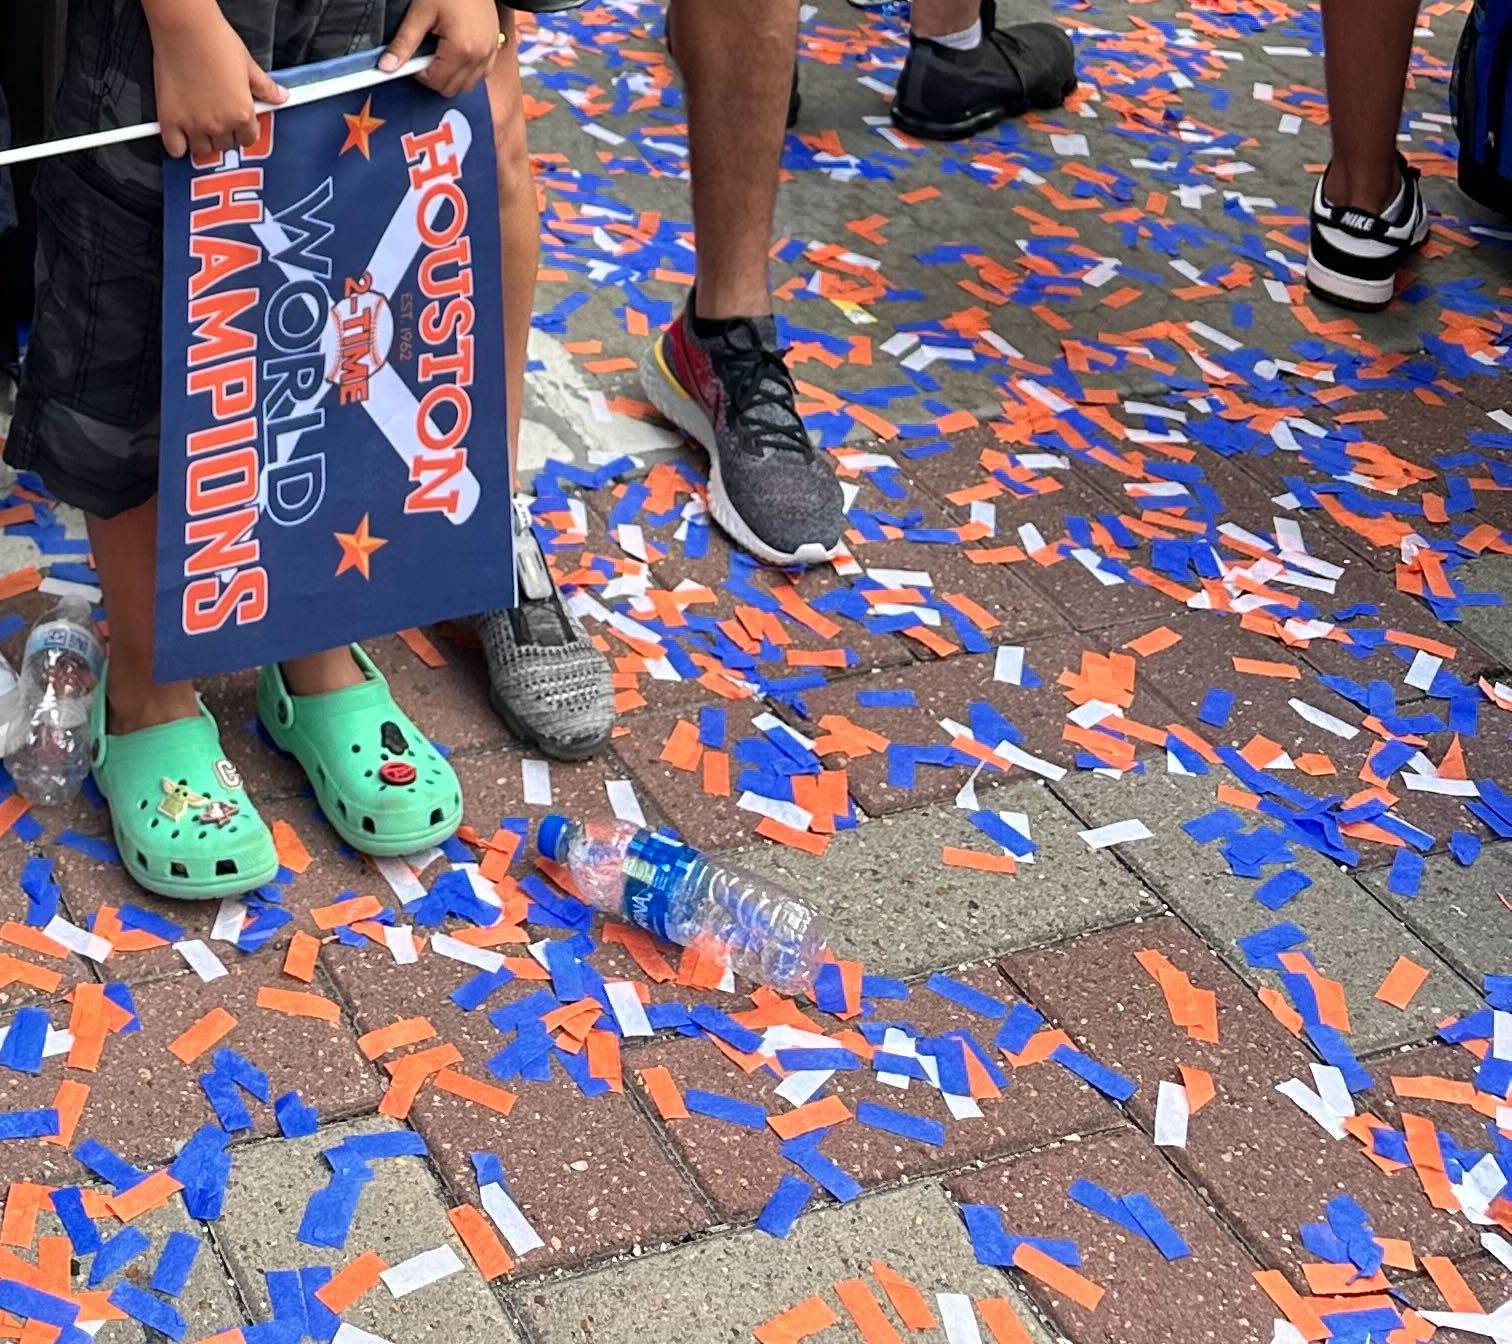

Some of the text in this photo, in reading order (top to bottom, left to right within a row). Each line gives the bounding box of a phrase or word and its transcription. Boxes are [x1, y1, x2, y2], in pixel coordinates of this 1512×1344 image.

[1340, 212, 1375, 231] NIKE
[262, 176, 335, 526] WORLD
[339, 272, 374, 405] 2-TIME
[400, 120, 474, 517] HOUSTON
[400, 328, 413, 361] 1962
